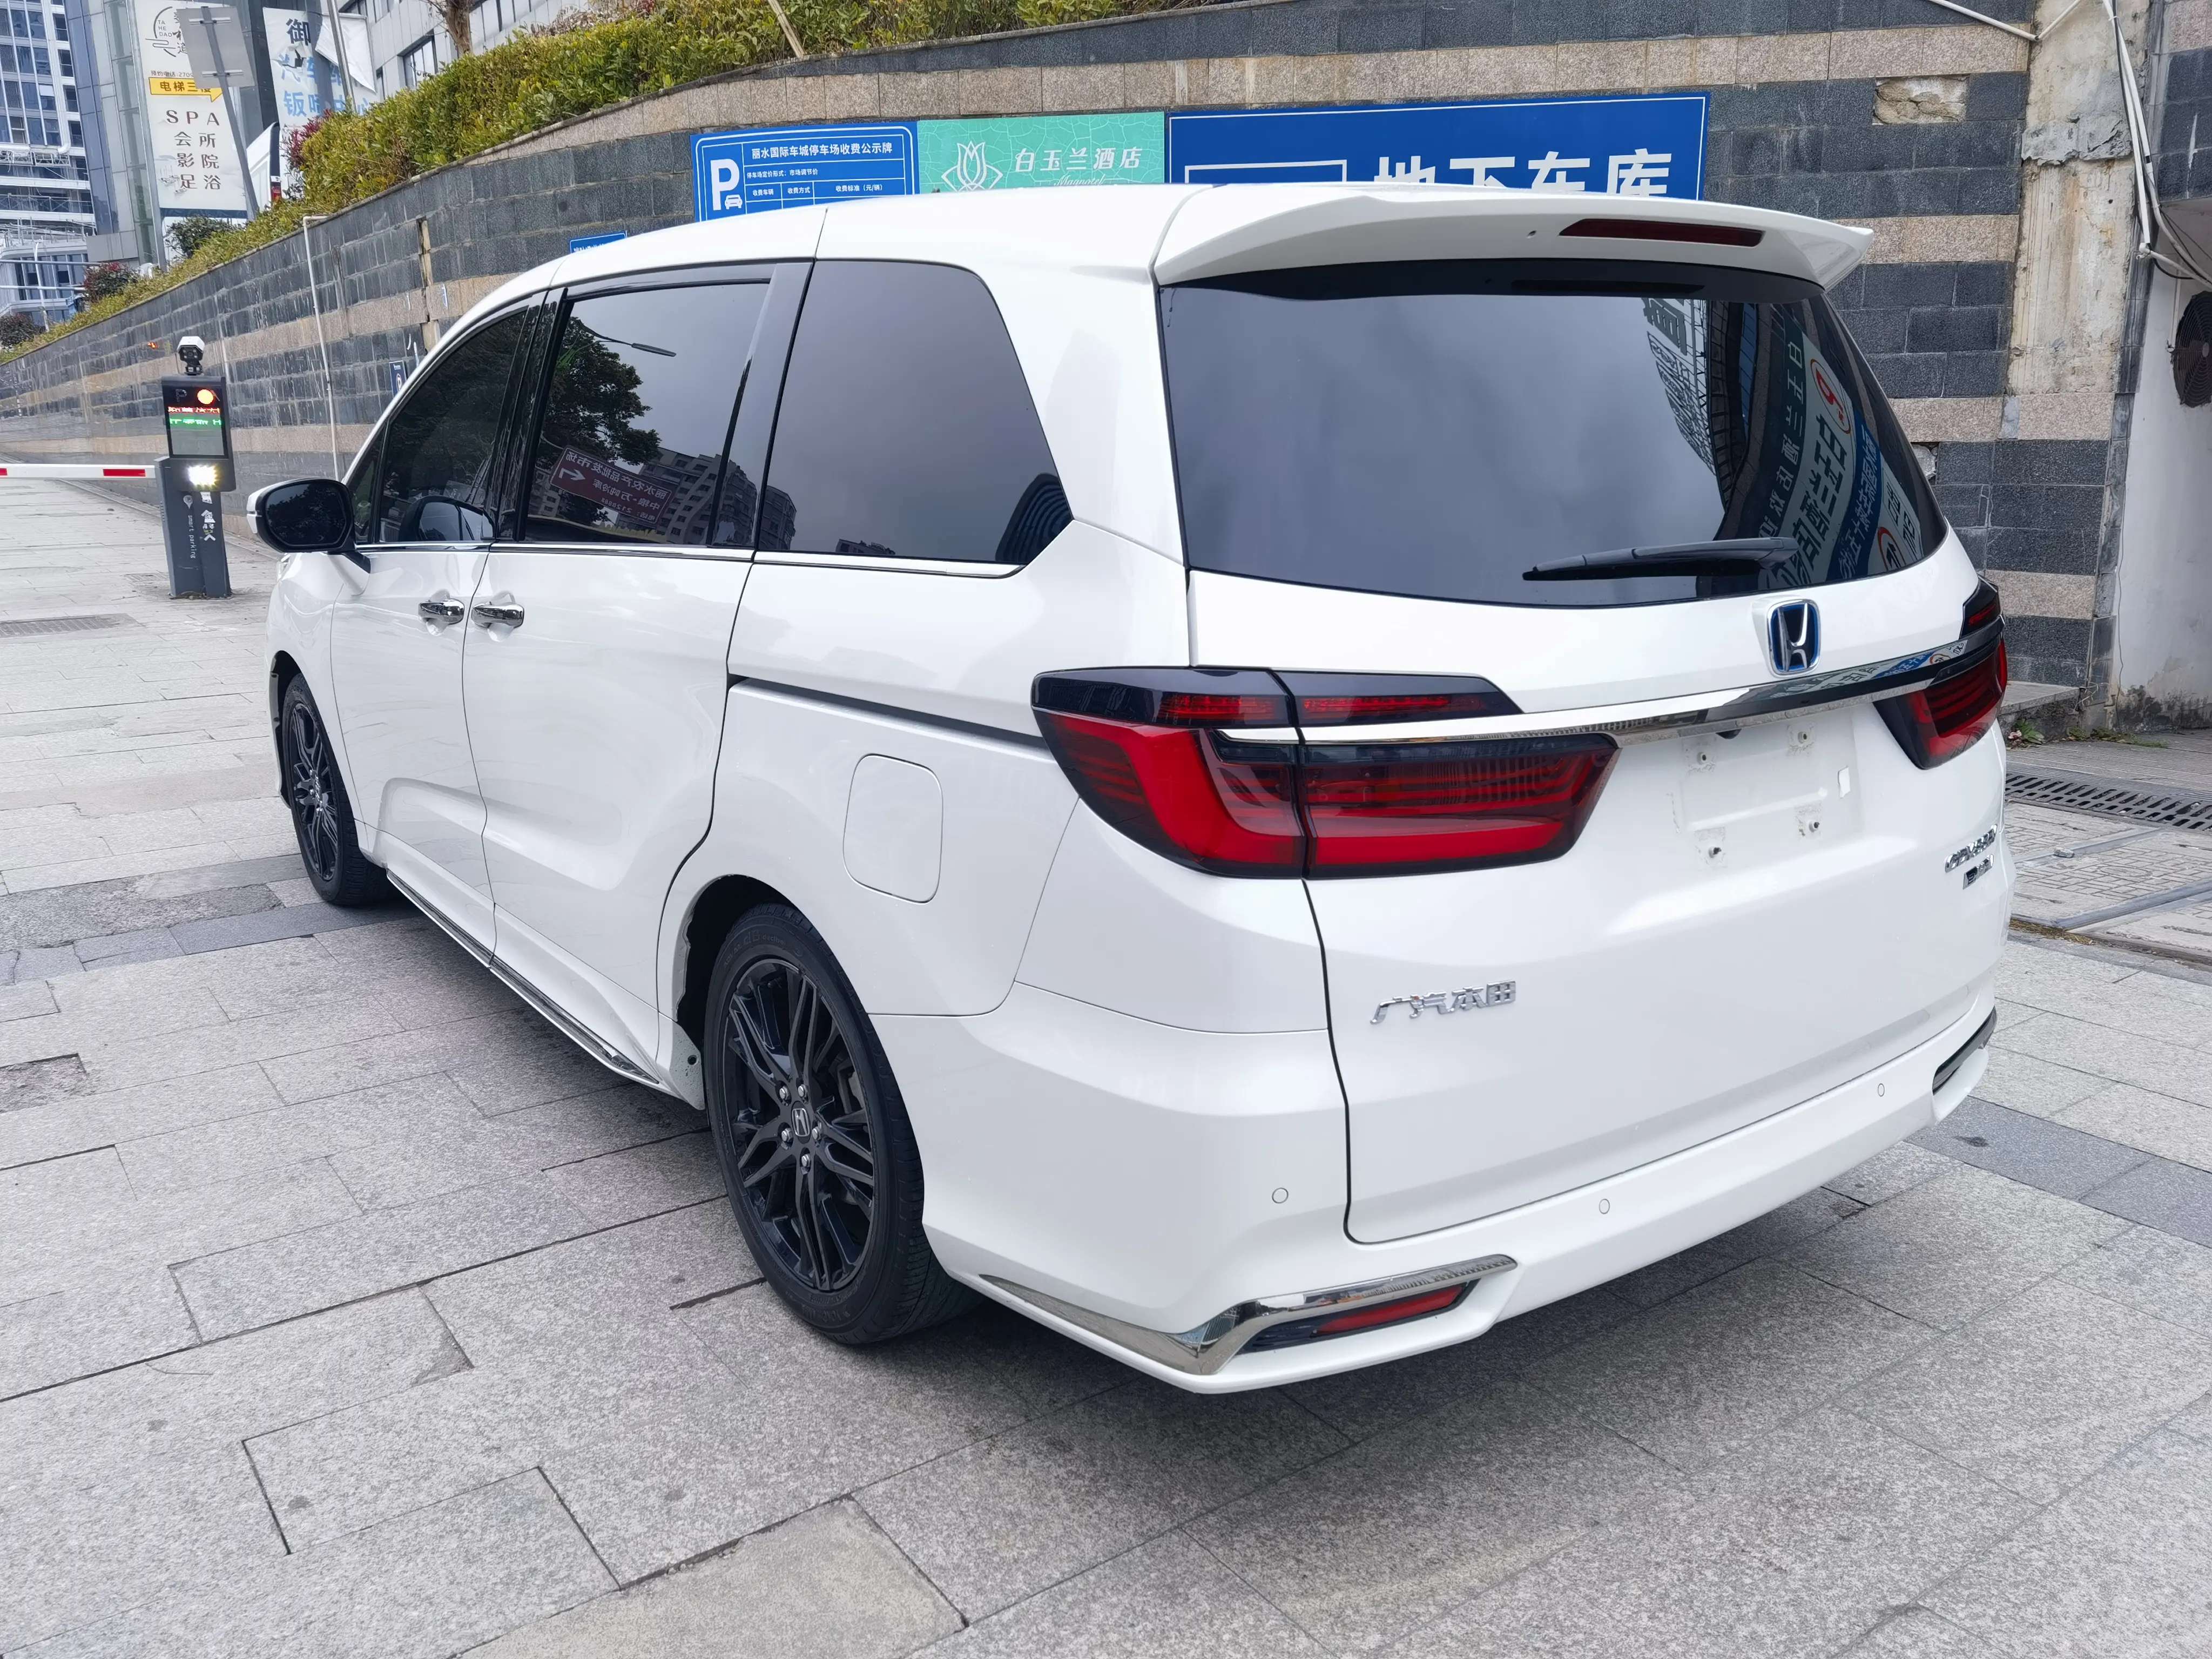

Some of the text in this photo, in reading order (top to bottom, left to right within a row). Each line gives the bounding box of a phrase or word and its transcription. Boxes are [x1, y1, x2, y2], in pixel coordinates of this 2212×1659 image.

[166, 110, 220, 126] SPA
[174, 131, 215, 148] 会所
[752, 142, 893, 160] 丽水国际车城停车场收费公示牌
[1015, 146, 1143, 172] 白玉兰酒店
[177, 153, 219, 168] 影院
[180, 174, 221, 190] 足浴
[1370, 979, 1516, 1024] 广汽本田
